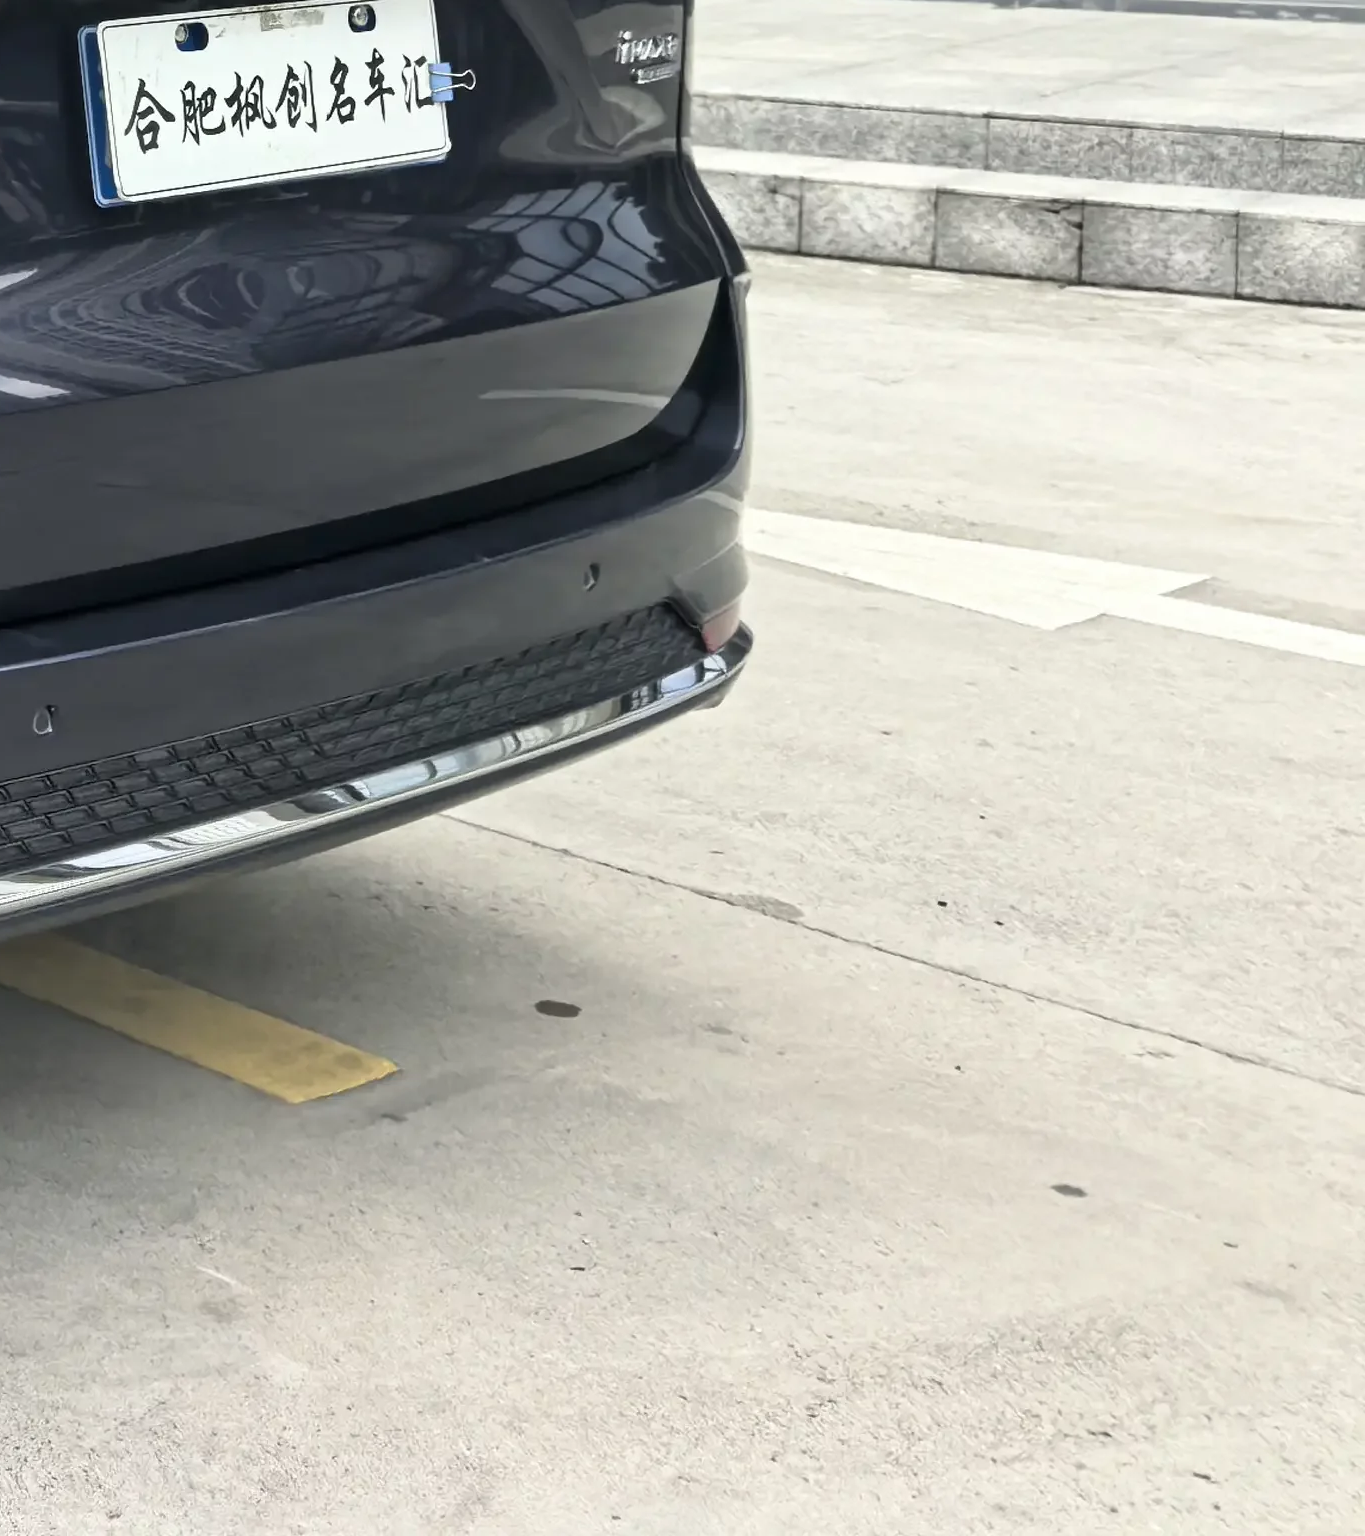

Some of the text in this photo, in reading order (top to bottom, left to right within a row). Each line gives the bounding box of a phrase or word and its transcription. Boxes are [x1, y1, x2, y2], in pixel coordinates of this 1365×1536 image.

[125, 48, 436, 154] 合肥枫创名车汇
